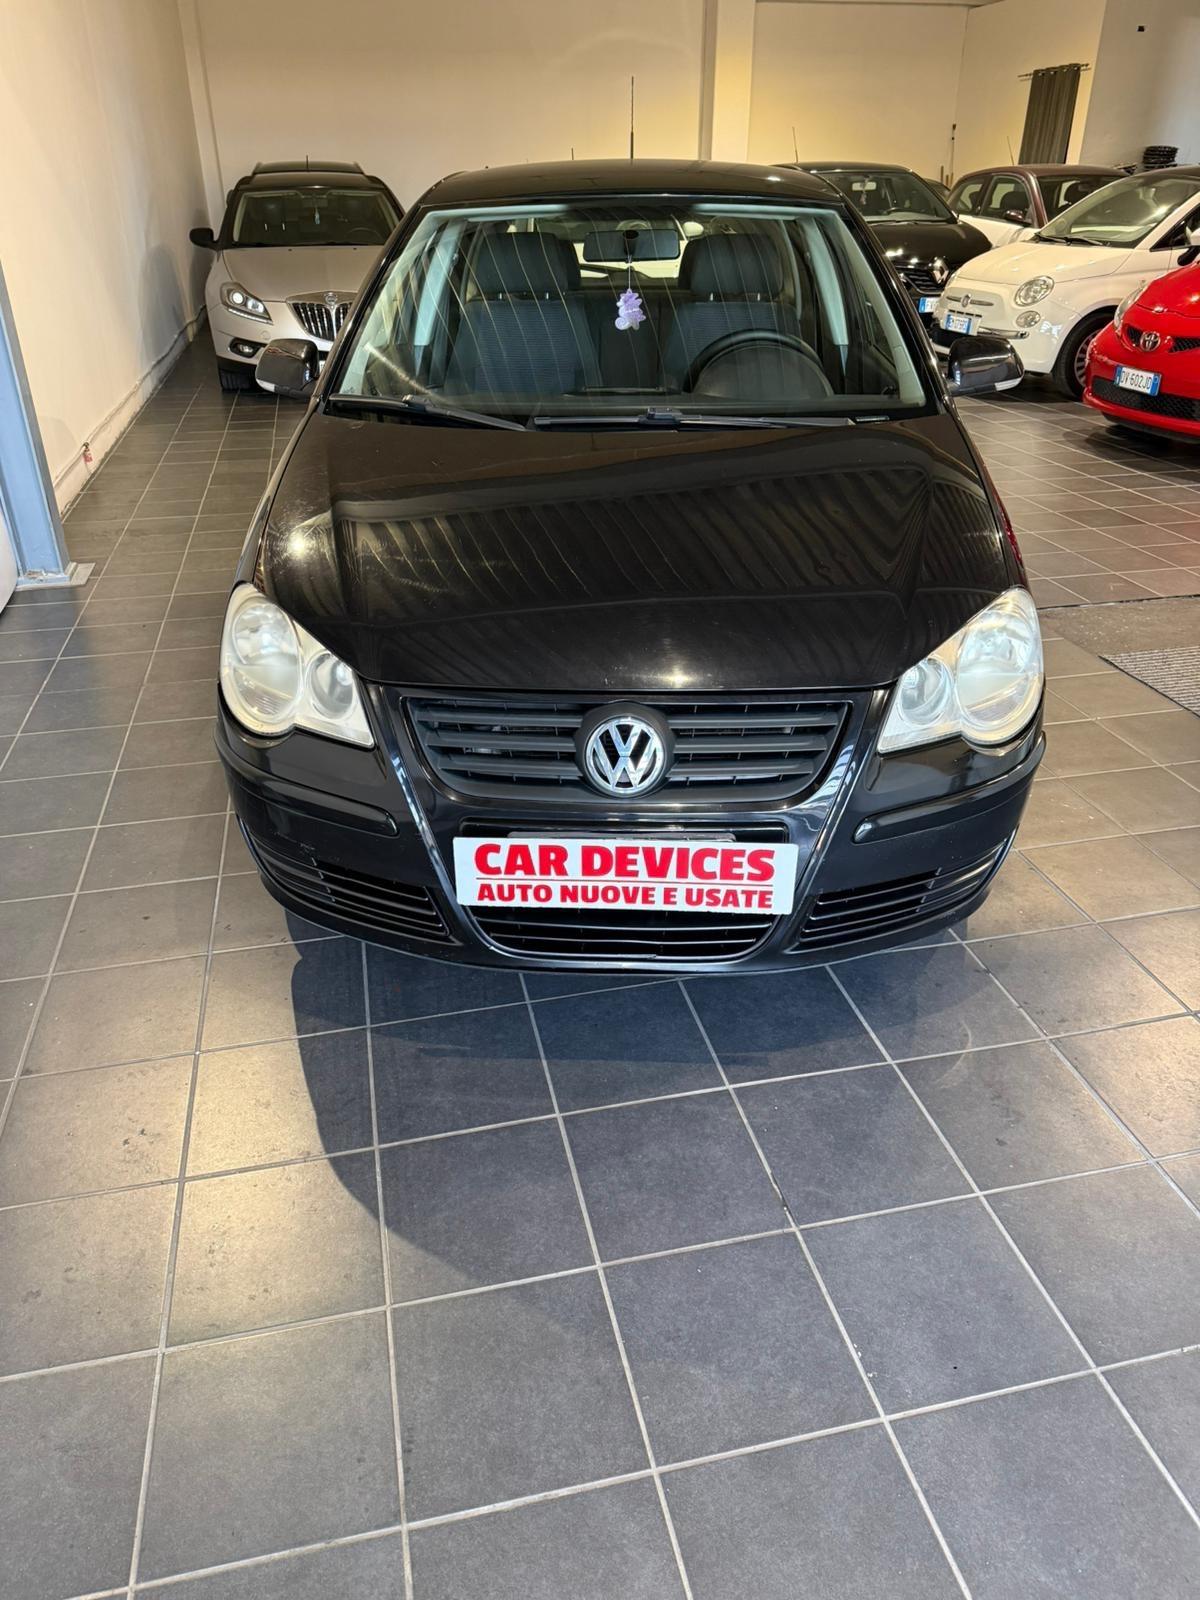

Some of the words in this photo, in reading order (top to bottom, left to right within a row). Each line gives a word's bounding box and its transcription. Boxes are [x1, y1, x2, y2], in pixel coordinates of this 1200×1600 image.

[586, 716, 664, 794] VW
[474, 843, 569, 877] CAR
[581, 845, 775, 882] DEVICES
[477, 883, 553, 903] AUTO
[560, 885, 656, 905] NUOVE
[663, 887, 678, 905] E
[685, 888, 773, 908] USATE
